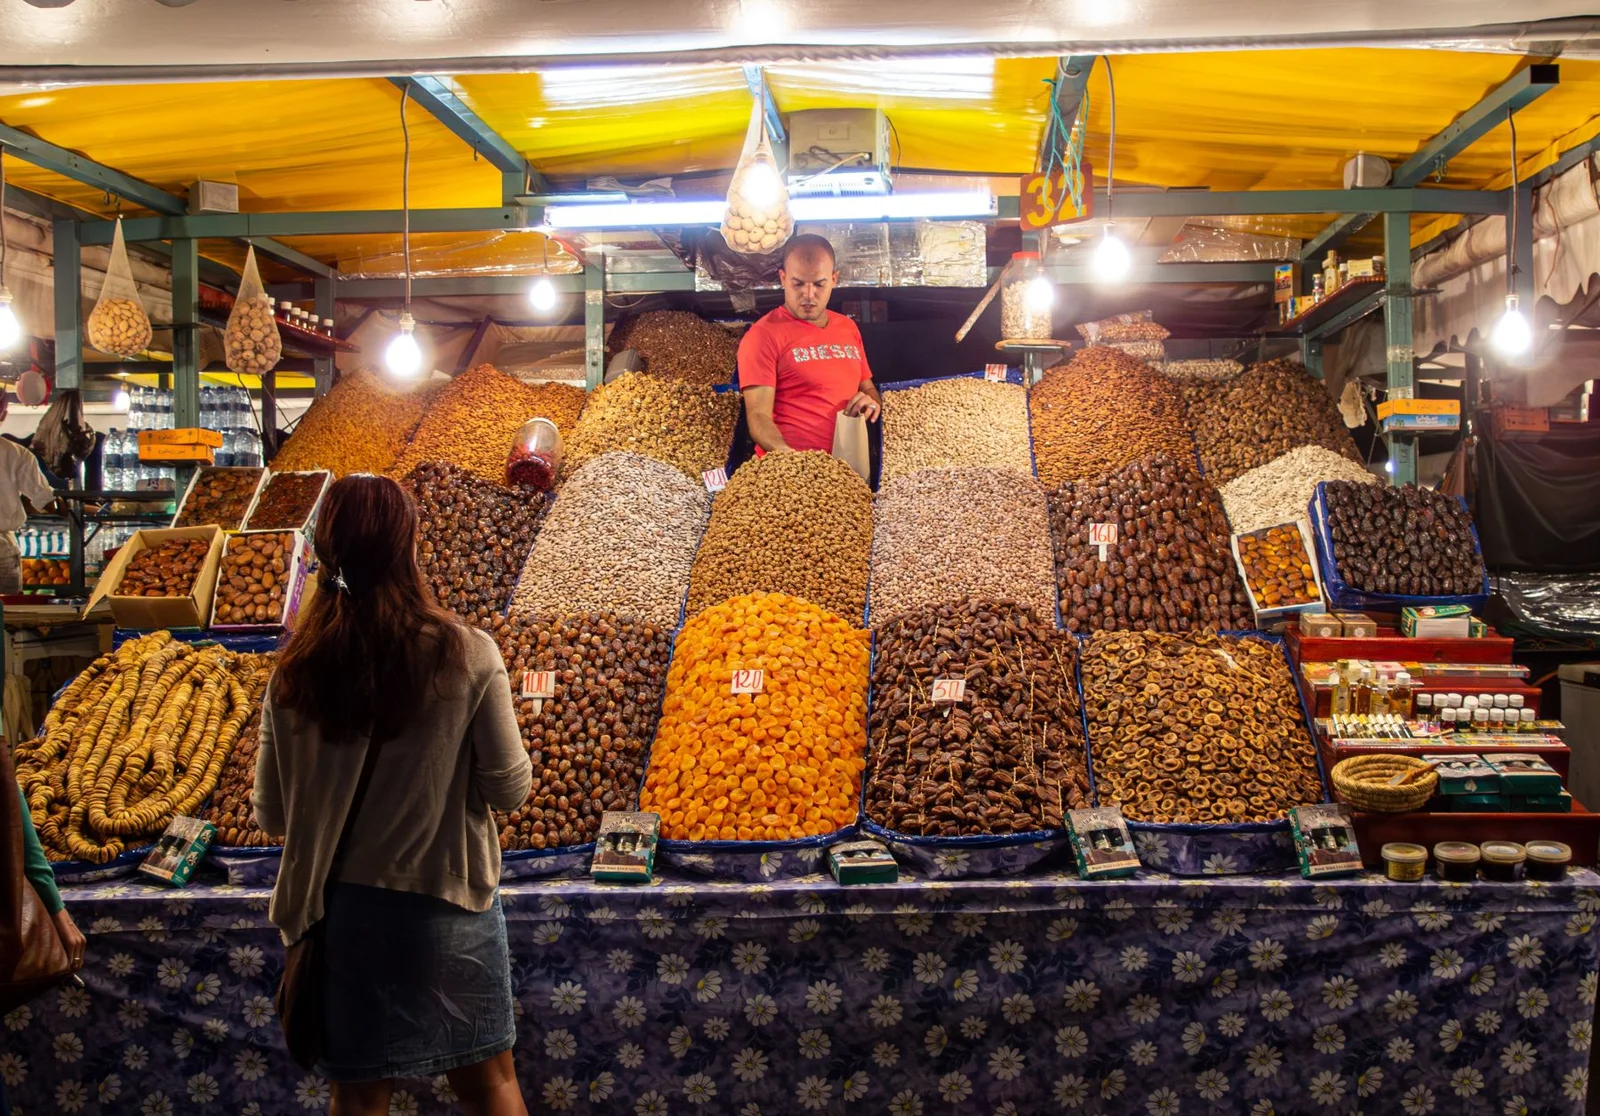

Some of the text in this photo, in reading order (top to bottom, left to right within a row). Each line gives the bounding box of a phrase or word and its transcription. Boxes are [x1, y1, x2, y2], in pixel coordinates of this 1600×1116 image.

[1026, 169, 1087, 227] 32
[1090, 523, 1117, 543] 160
[524, 672, 549, 694] 100
[733, 670, 762, 689] 120
[934, 680, 960, 698] 50
